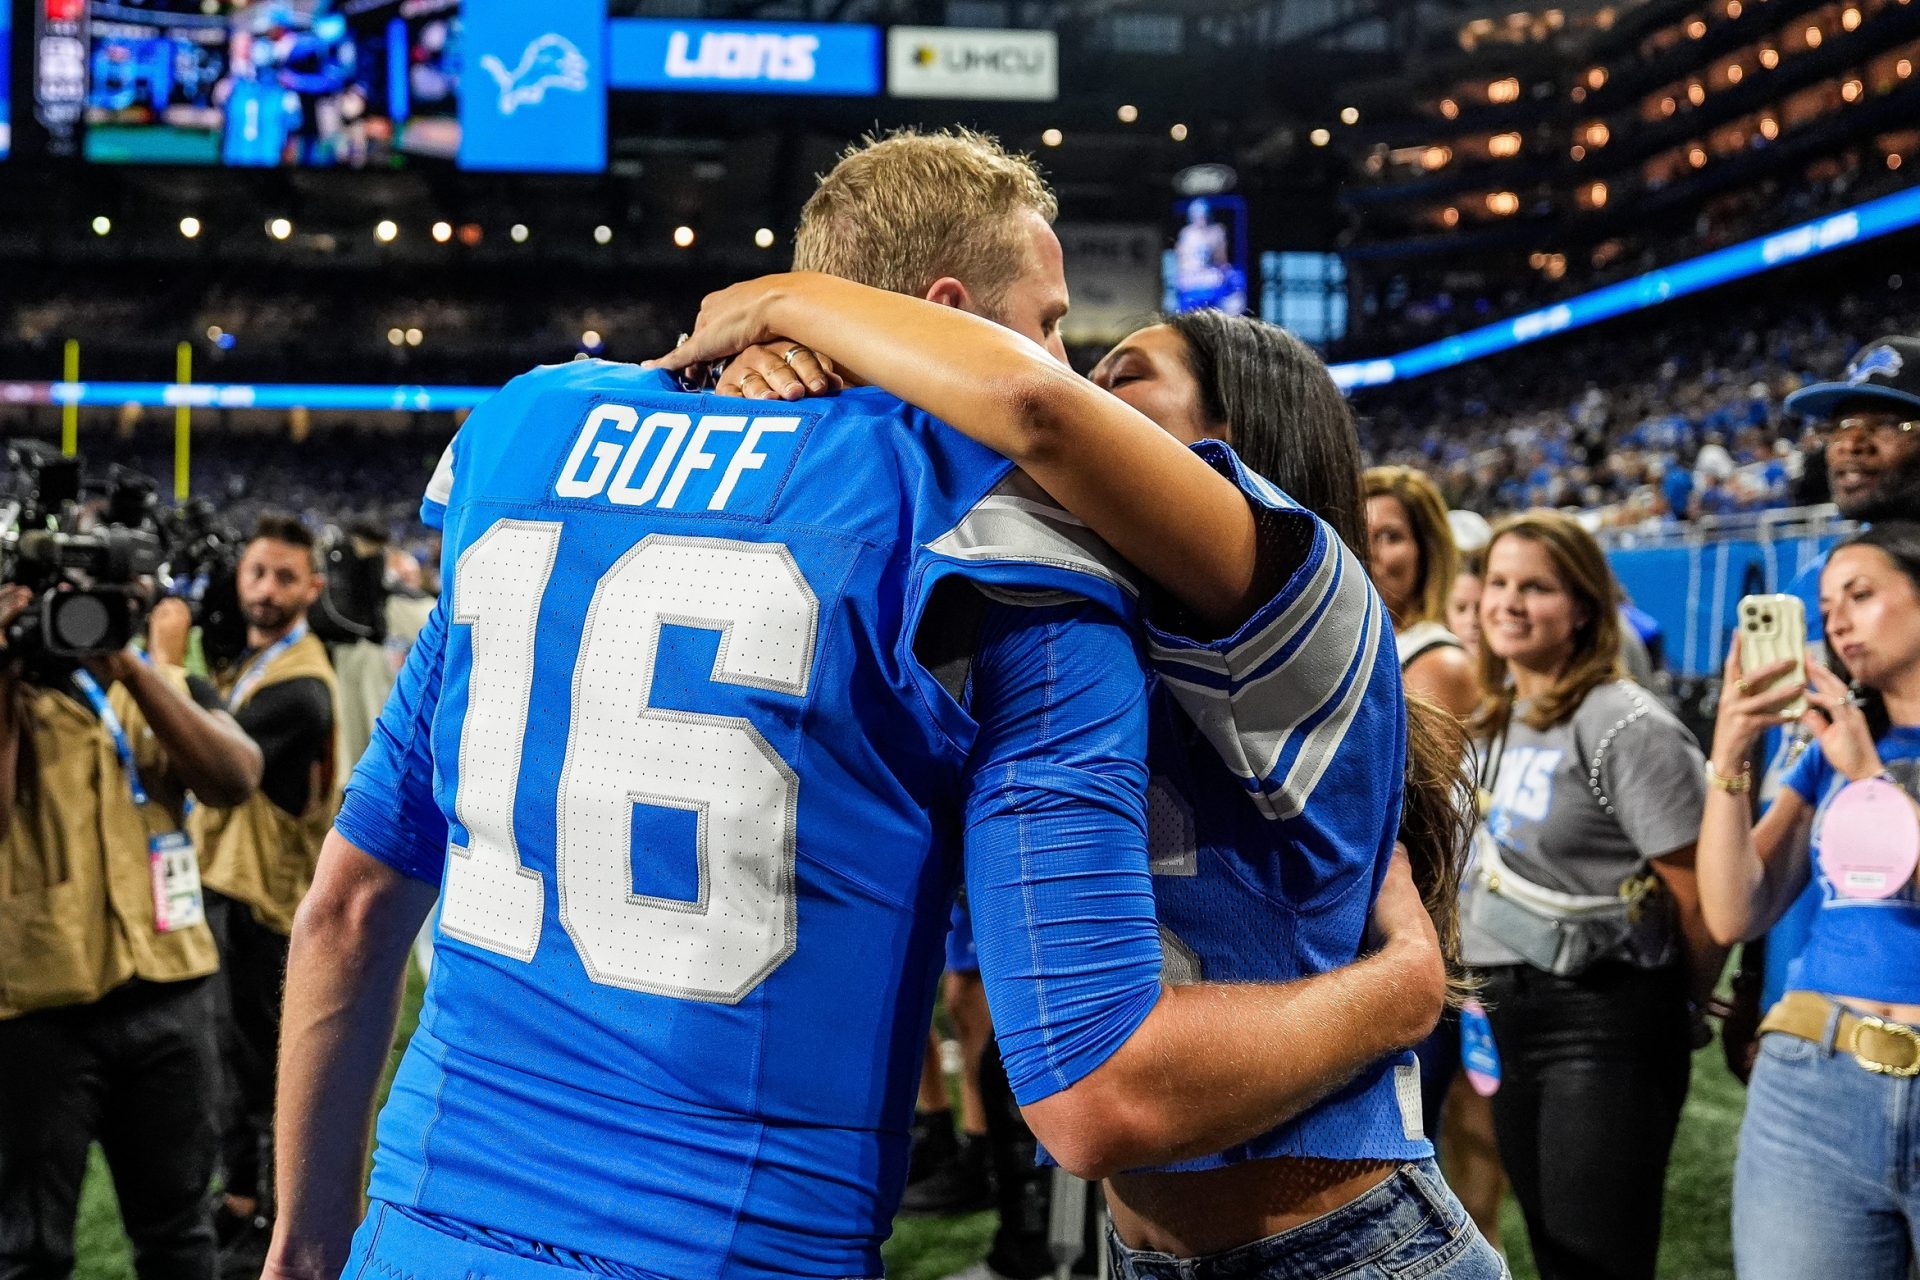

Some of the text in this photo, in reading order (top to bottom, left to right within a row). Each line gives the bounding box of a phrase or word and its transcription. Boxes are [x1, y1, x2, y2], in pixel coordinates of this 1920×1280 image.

[664, 31, 820, 80] LIONS
[555, 403, 801, 510] GOFF
[440, 518, 820, 1004] 16
